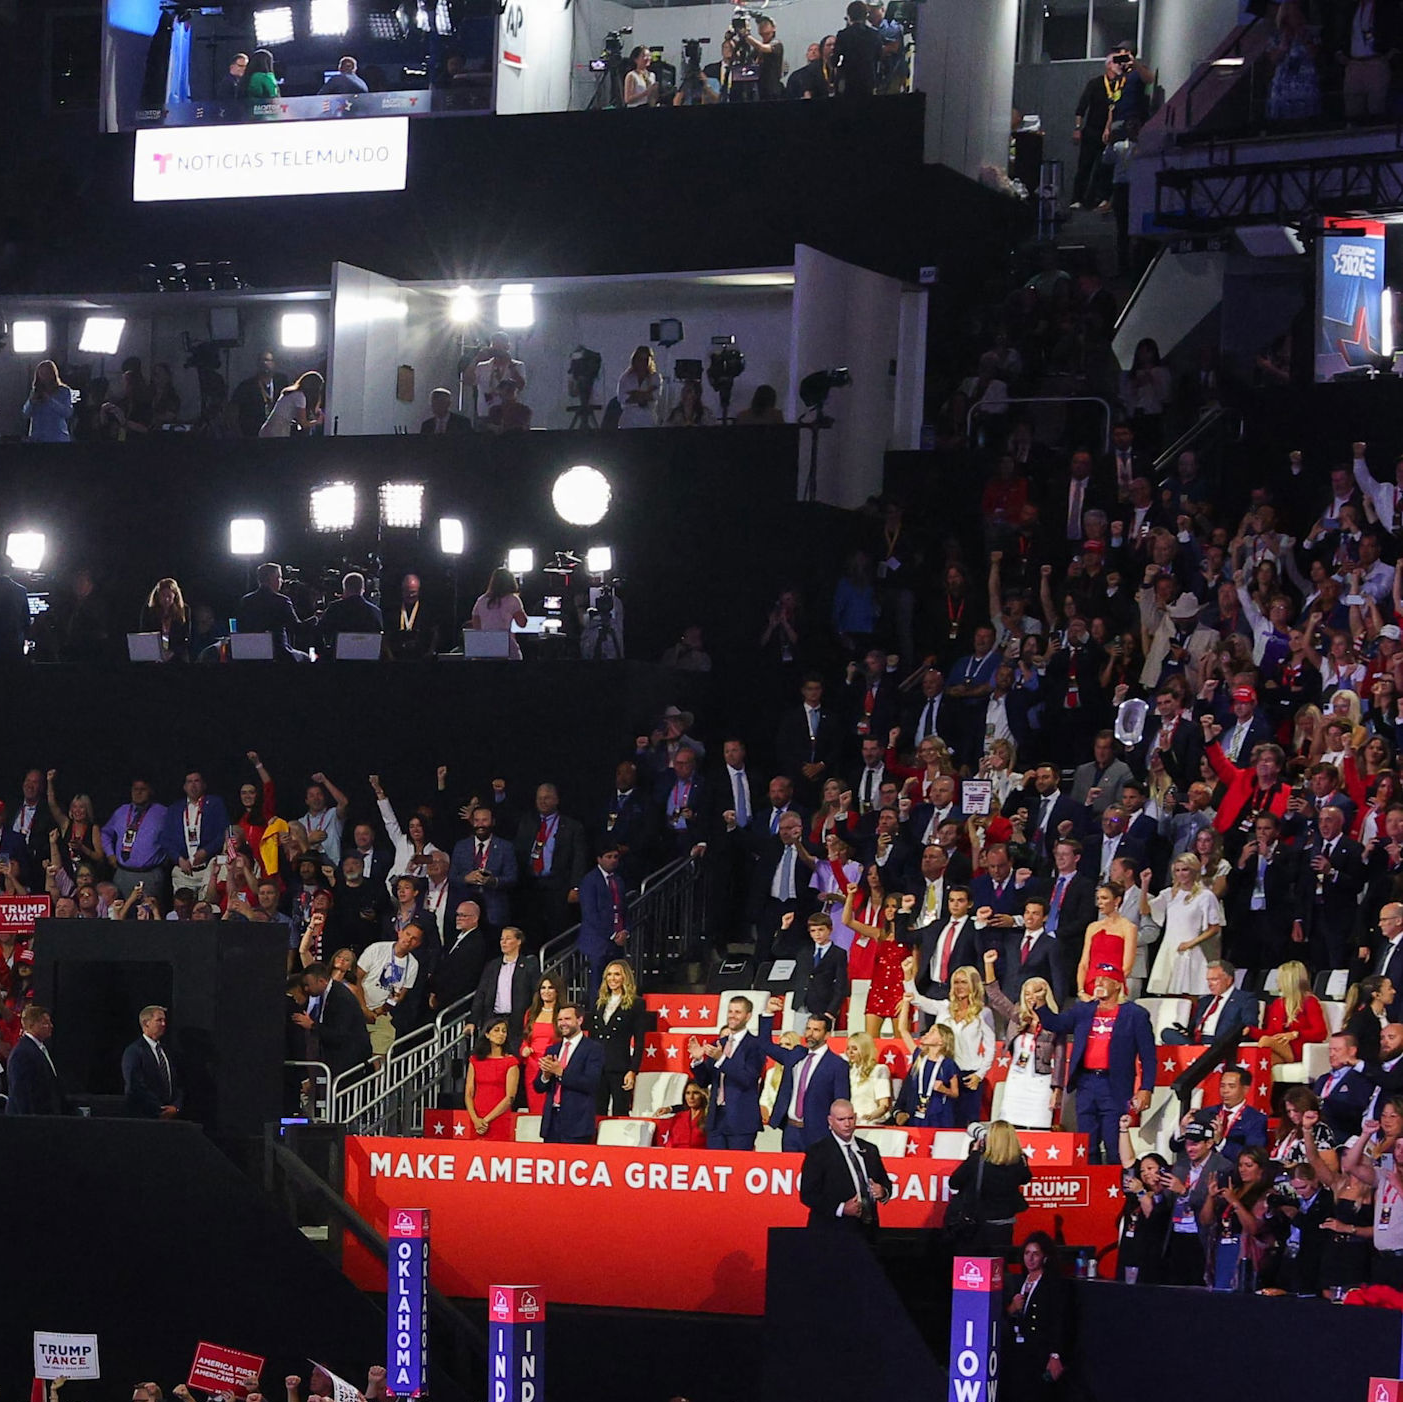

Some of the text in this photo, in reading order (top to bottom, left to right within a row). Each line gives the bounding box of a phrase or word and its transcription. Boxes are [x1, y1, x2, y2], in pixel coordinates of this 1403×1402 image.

[178, 146, 389, 171] NOTICIAS TELEMUNDO
[1341, 256, 1367, 277] 2024
[0, 904, 47, 914] TRUMP
[370, 1152, 734, 1192] MAKE AMERICA GREAT
[1021, 1181, 1081, 1198] TRUMP
[396, 1242, 412, 1386] OKLAHOMA
[421, 1241, 429, 1385] OKLAHOMA
[39, 1343, 92, 1356] TRUMP
[44, 1355, 87, 1365] VANCE
[194, 1369, 235, 1384] AMERICANS
[196, 1356, 258, 1378] AMERICA FIRST
